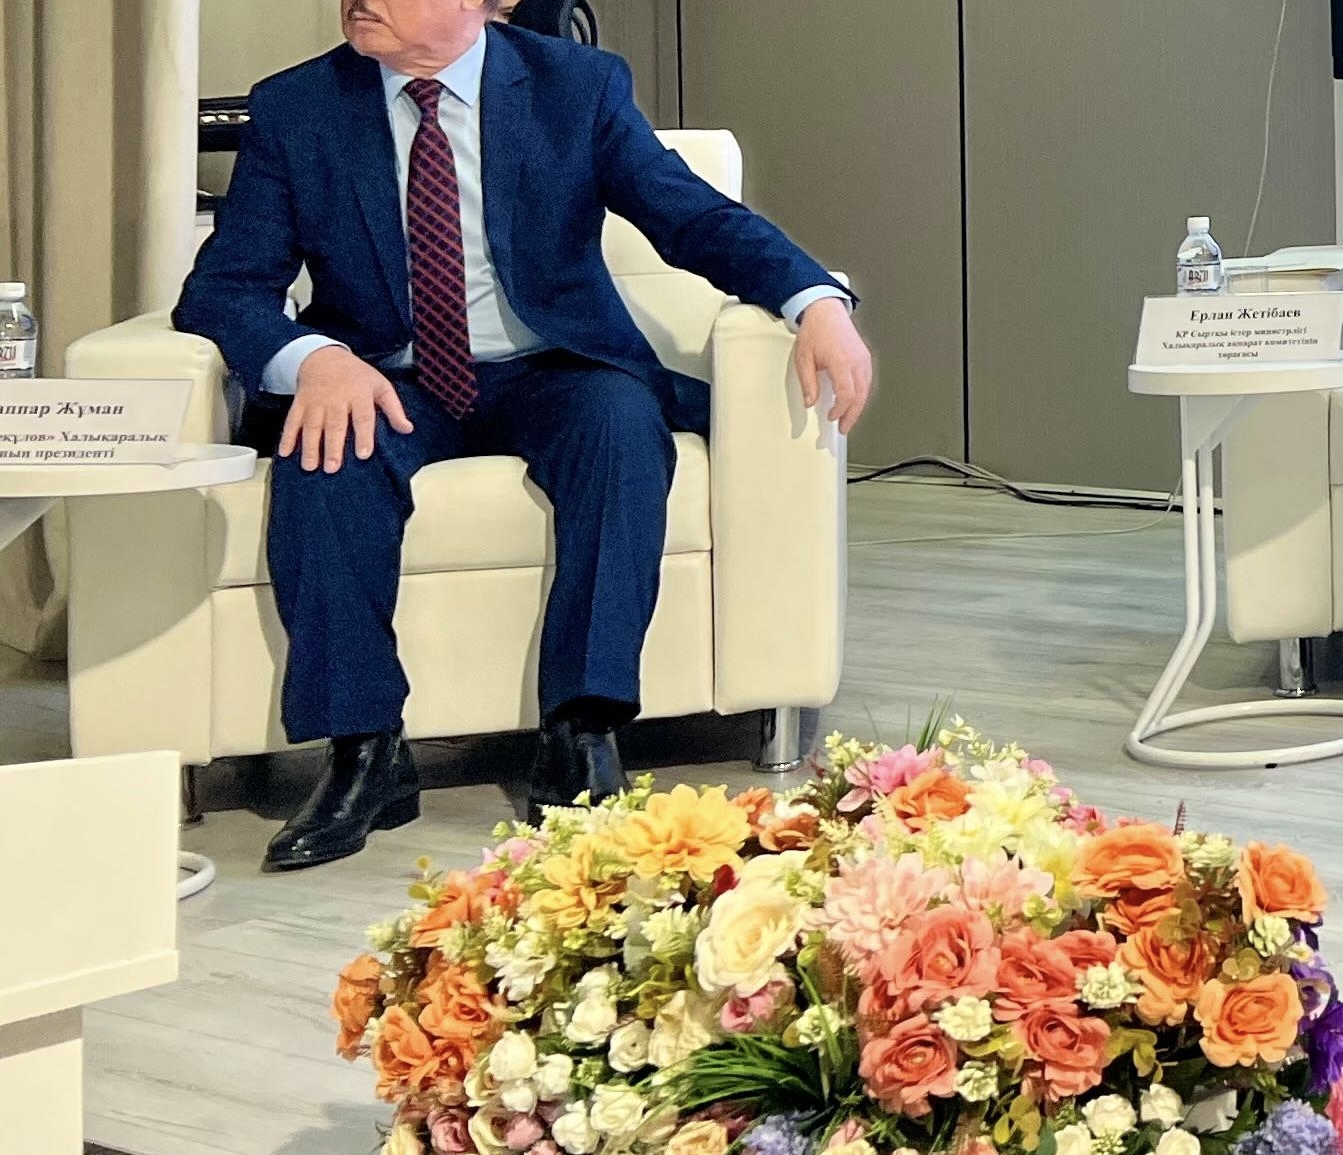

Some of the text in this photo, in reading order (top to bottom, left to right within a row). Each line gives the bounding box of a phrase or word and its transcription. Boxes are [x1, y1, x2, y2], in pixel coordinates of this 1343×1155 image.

[1190, 308, 1301, 323] Ерлан Жетібаев
[35, 448, 115, 460] президенті
